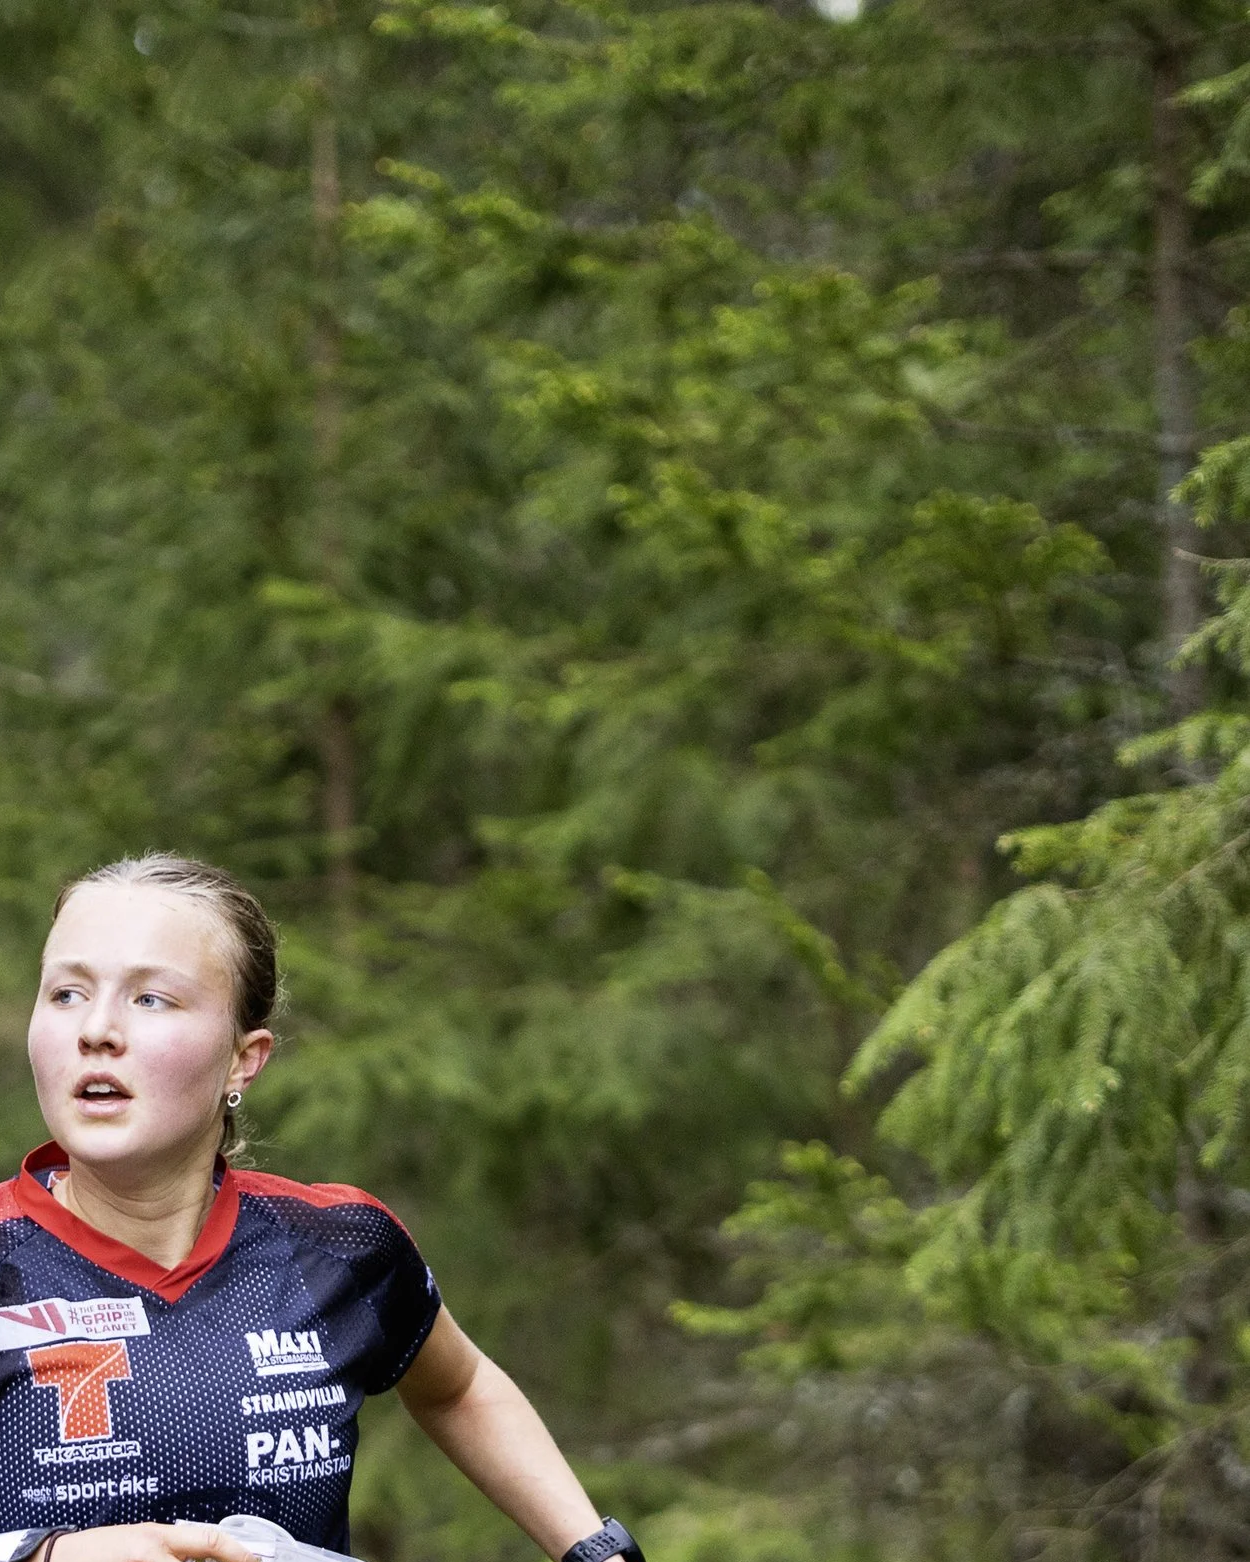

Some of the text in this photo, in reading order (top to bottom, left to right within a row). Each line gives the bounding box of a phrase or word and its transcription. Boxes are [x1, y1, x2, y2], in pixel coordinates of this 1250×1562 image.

[81, 1311, 123, 1326] GRIP
[97, 1302, 132, 1311] BEST
[85, 1322, 138, 1334] PLANET
[241, 1384, 347, 1416] STRANDVILLAN
[33, 1440, 141, 1465] T-KARTOR
[246, 1423, 340, 1468] PAN-
[248, 1454, 351, 1486] KRISTIANSTAD
